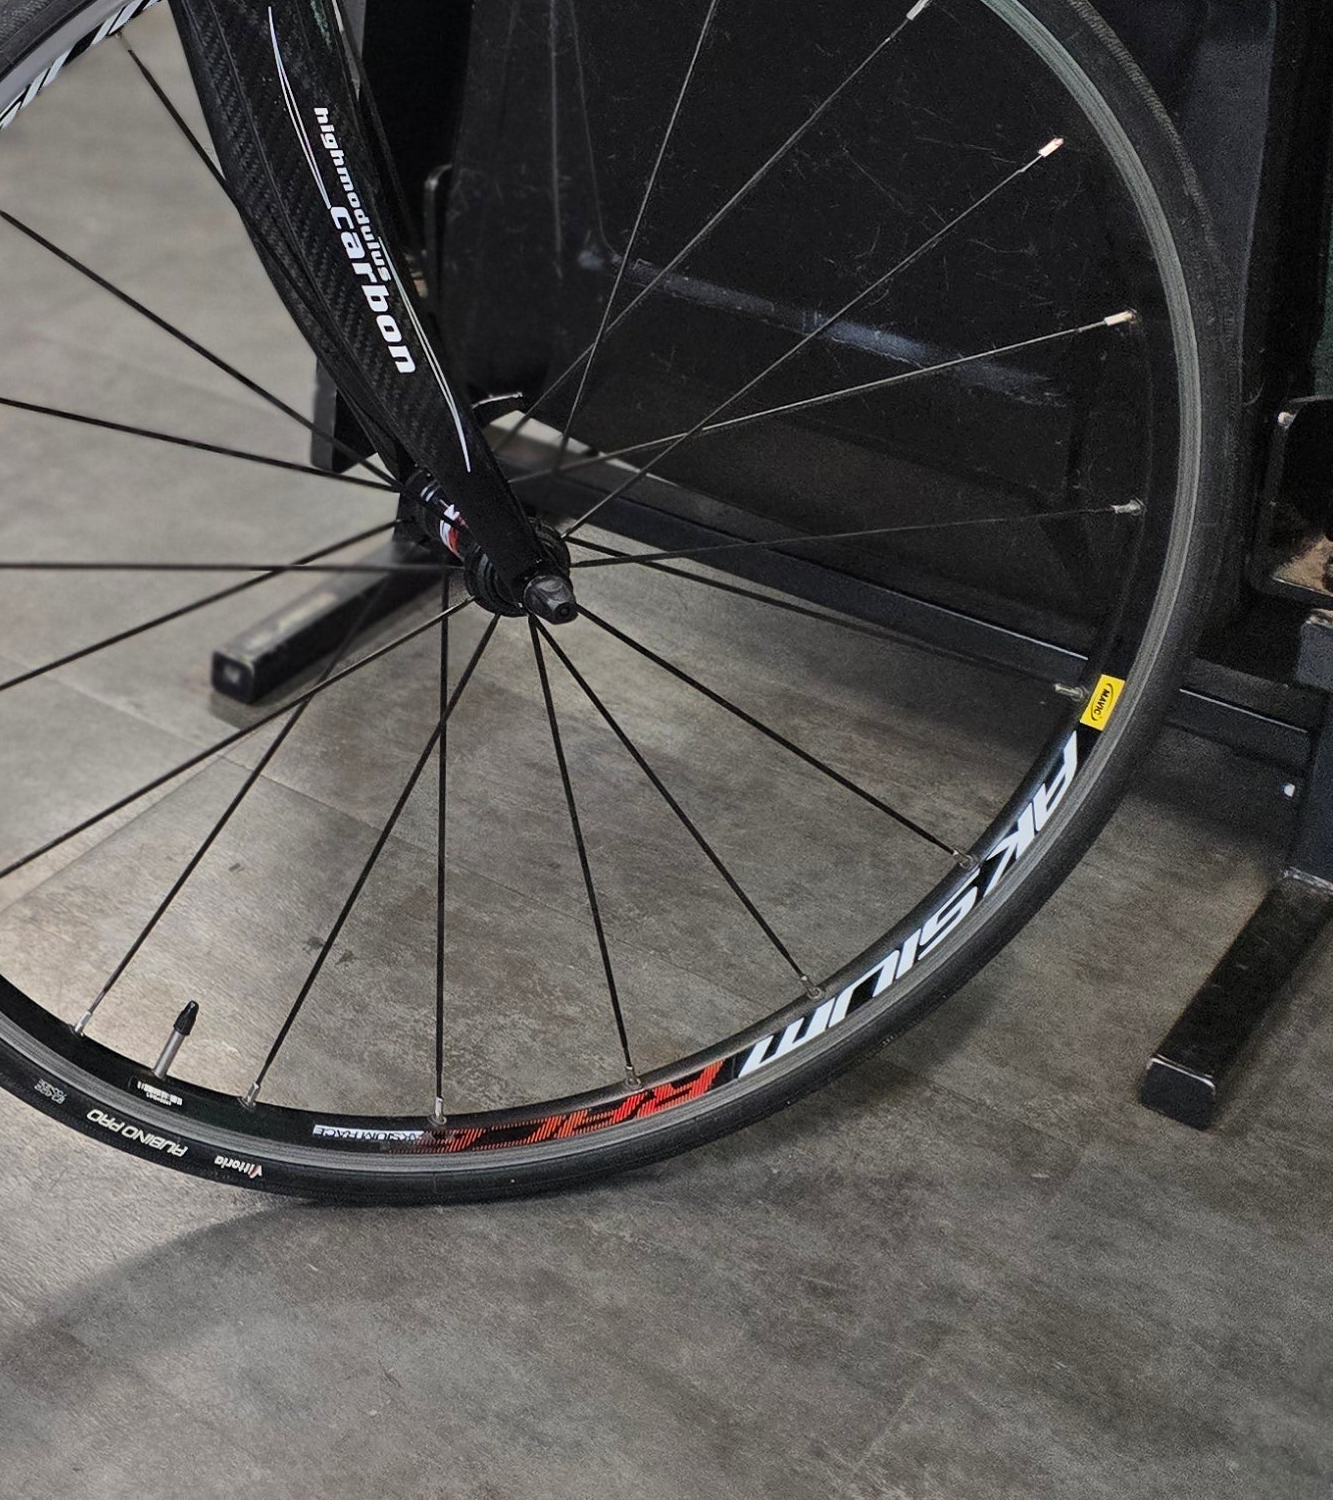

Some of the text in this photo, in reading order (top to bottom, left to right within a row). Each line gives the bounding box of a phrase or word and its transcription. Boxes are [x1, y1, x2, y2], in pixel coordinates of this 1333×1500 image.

[330, 205, 416, 373] carbon
[1093, 688, 1110, 716] MAVIC
[738, 731, 1078, 1078] AKSIUM
[86, 1108, 189, 1158] RUBINO PRO
[214, 1155, 263, 1179] Vittoria
